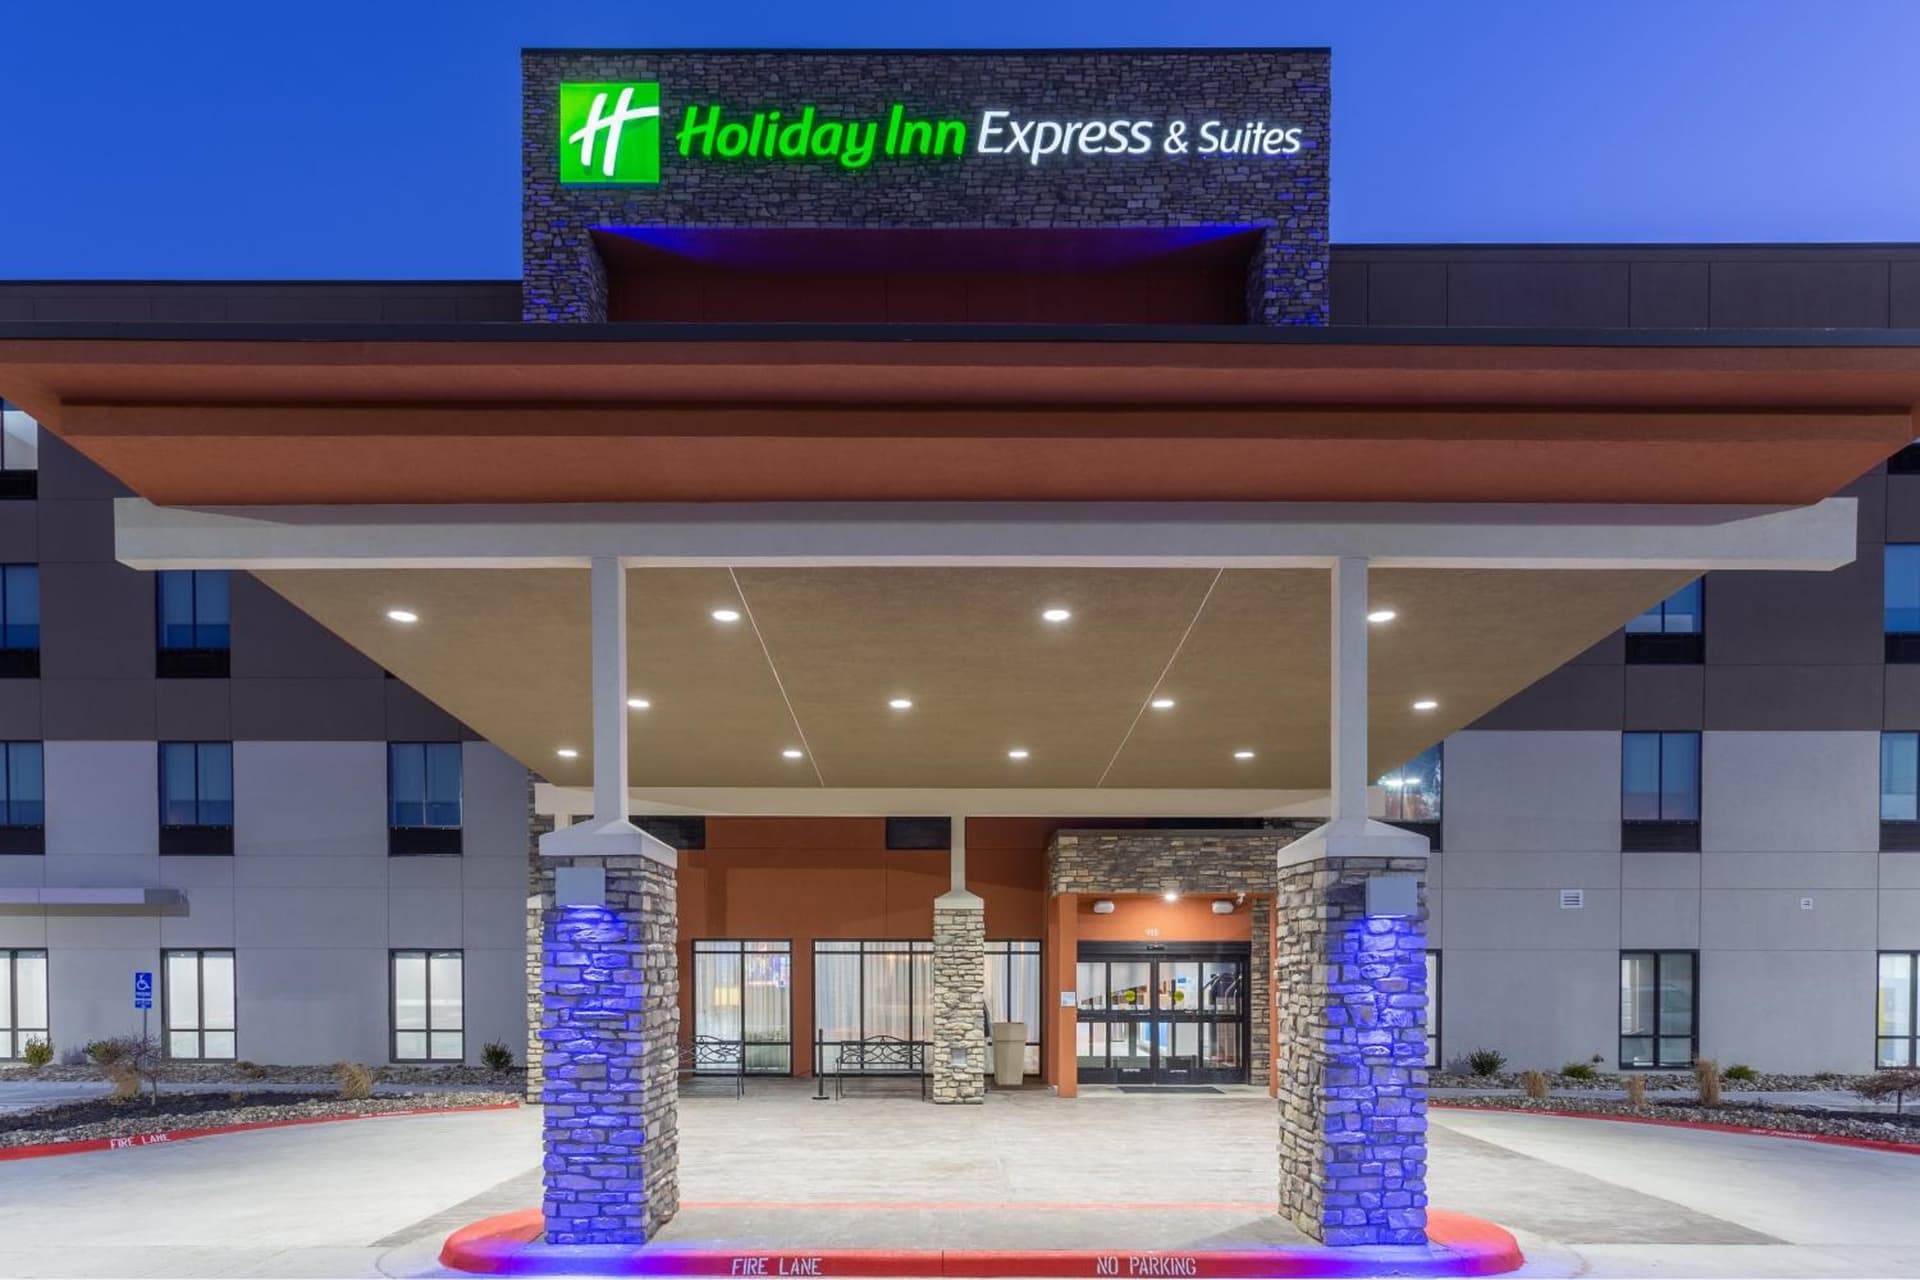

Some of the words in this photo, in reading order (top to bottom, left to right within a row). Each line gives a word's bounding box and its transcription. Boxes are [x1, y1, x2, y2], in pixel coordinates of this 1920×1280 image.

[676, 105, 878, 169] Holiday
[885, 104, 966, 155] Inn
[977, 110, 1153, 166] Express
[1163, 120, 1189, 155] &
[1198, 120, 1303, 155] Suites
[110, 1136, 136, 1149] FIRE
[141, 1133, 171, 1145] LANE
[732, 1257, 769, 1276] FIRE
[779, 1257, 823, 1276] LANE
[1097, 1256, 1119, 1275] NO
[1129, 1256, 1197, 1276] PARKING
